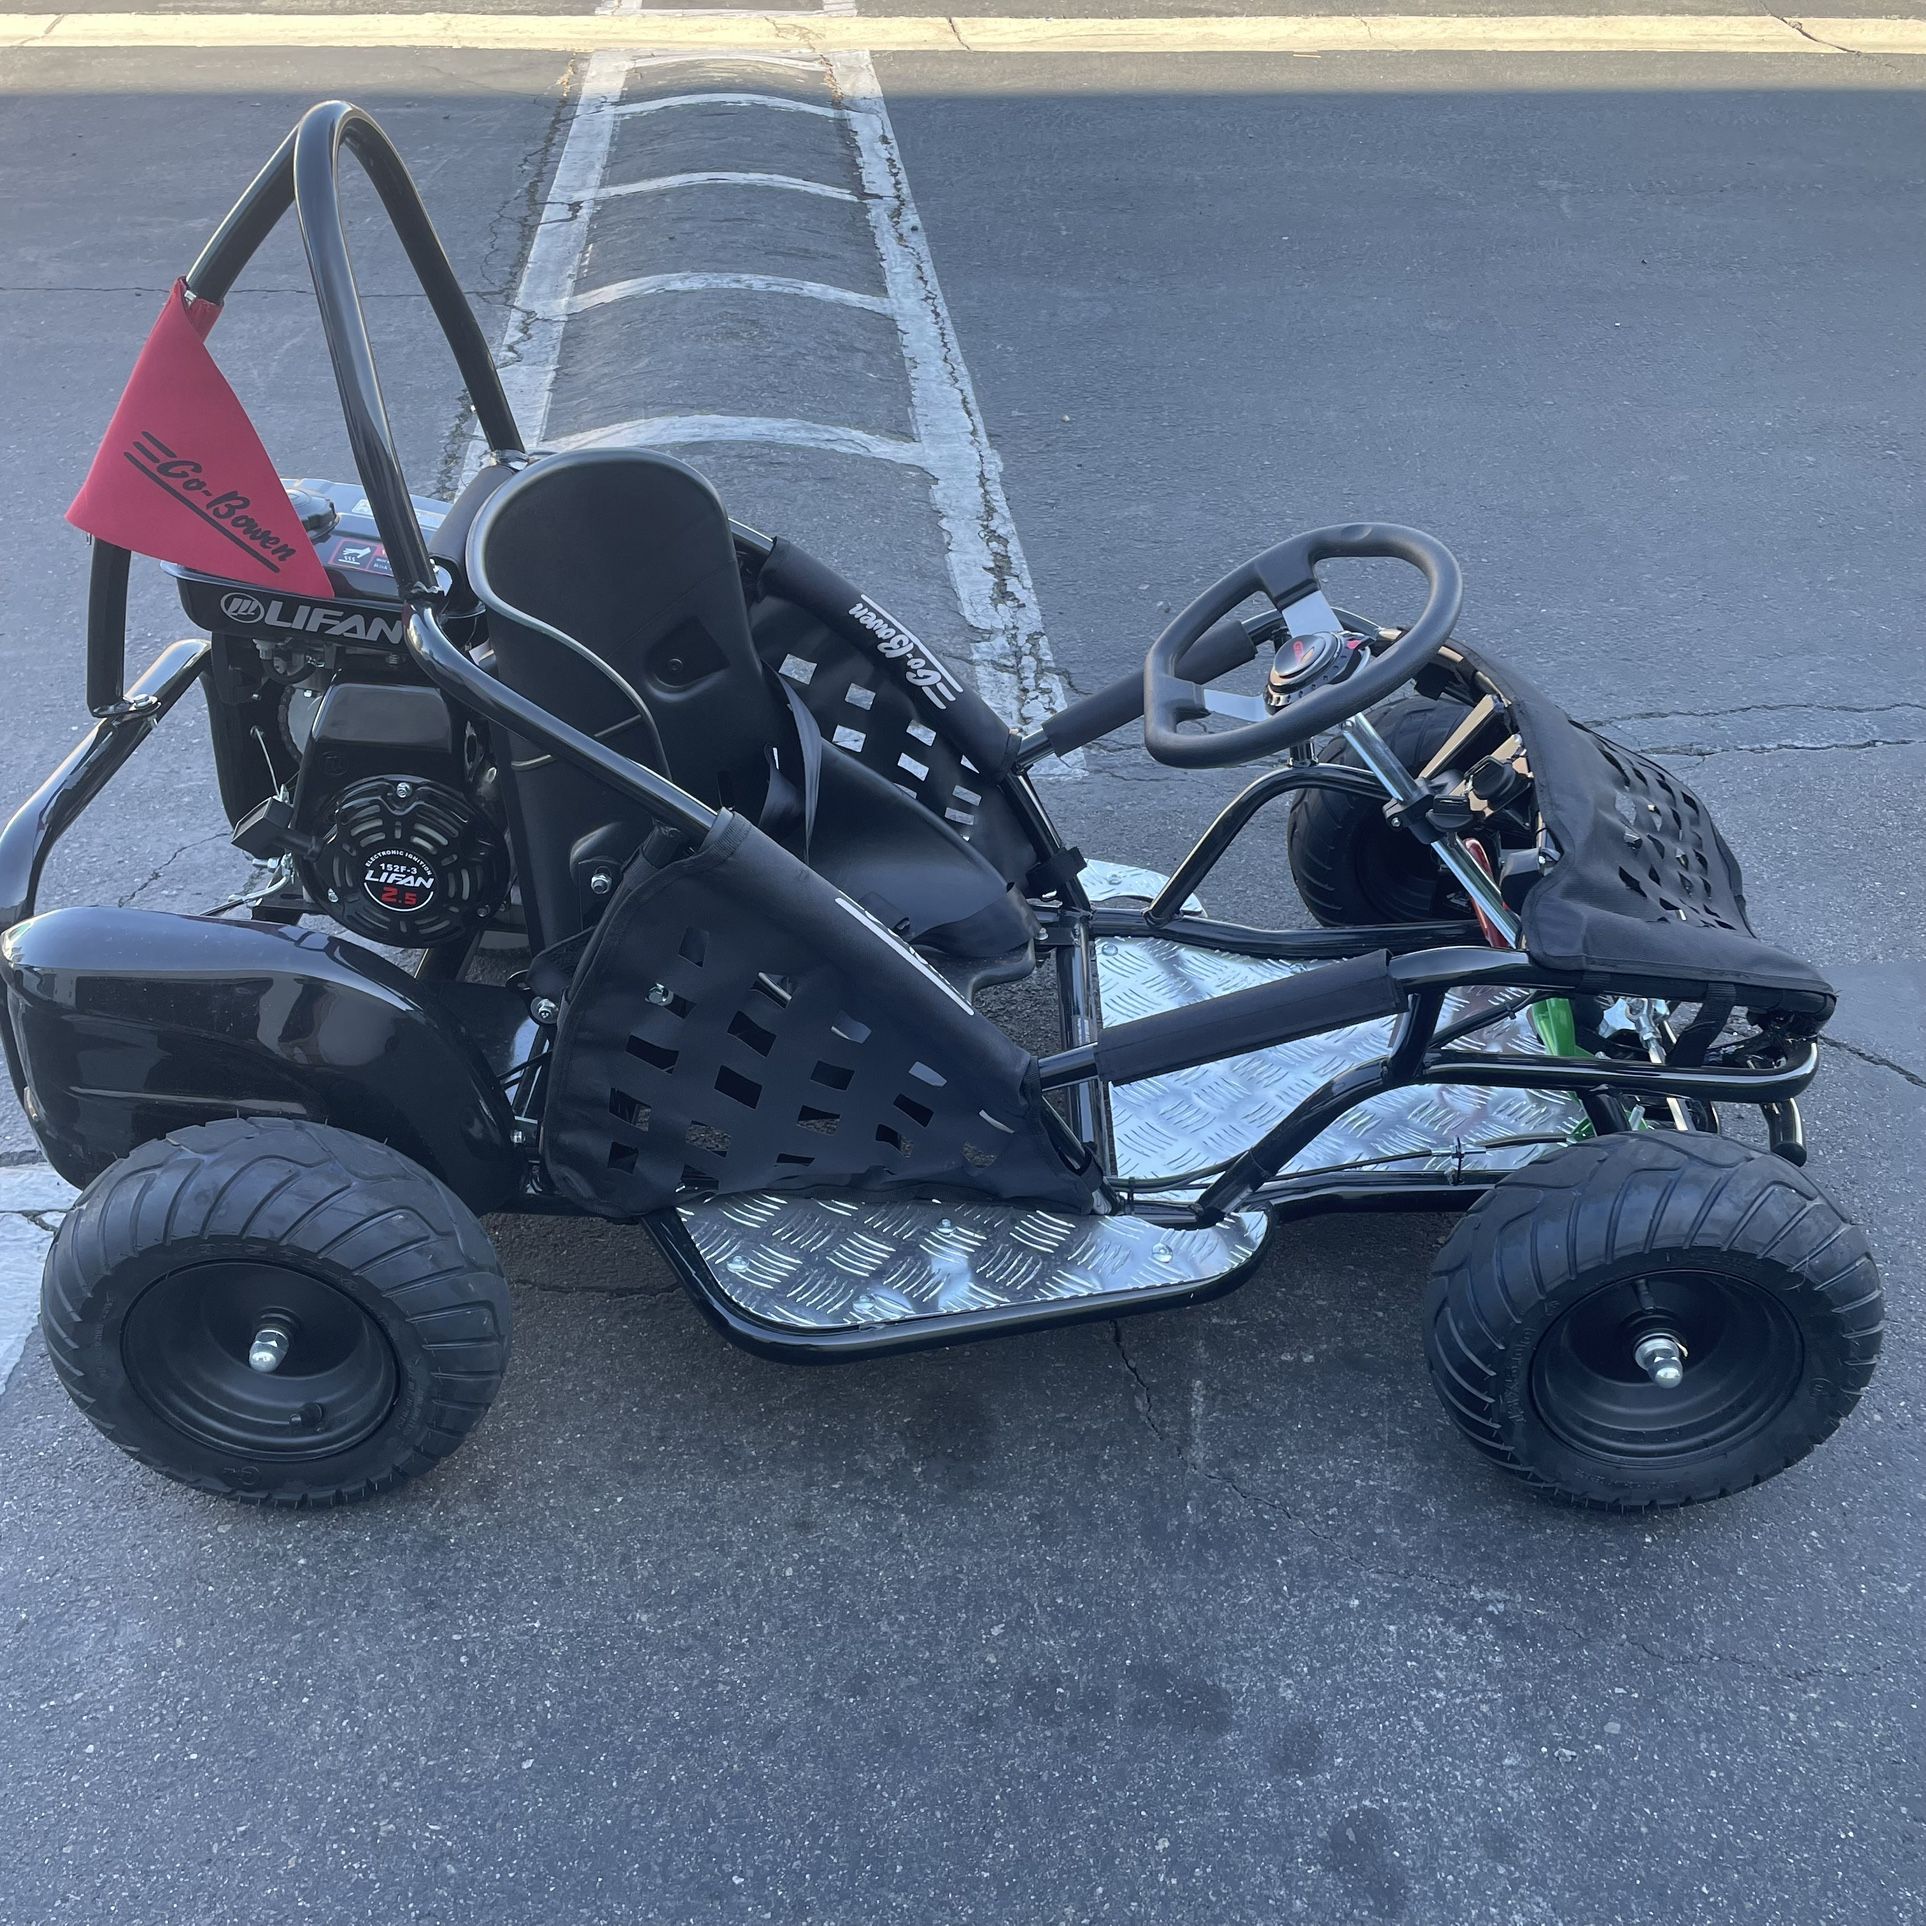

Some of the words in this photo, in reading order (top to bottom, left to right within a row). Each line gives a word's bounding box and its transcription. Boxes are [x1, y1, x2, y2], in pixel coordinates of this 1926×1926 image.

[264, 600, 403, 644] LIFAN
[365, 850, 404, 867] ELECTRONIC
[405, 852, 433, 875] IGNITION
[380, 863, 418, 875] 152F-3
[365, 870, 435, 889] LIFAN
[381, 886, 417, 905] 2.5
